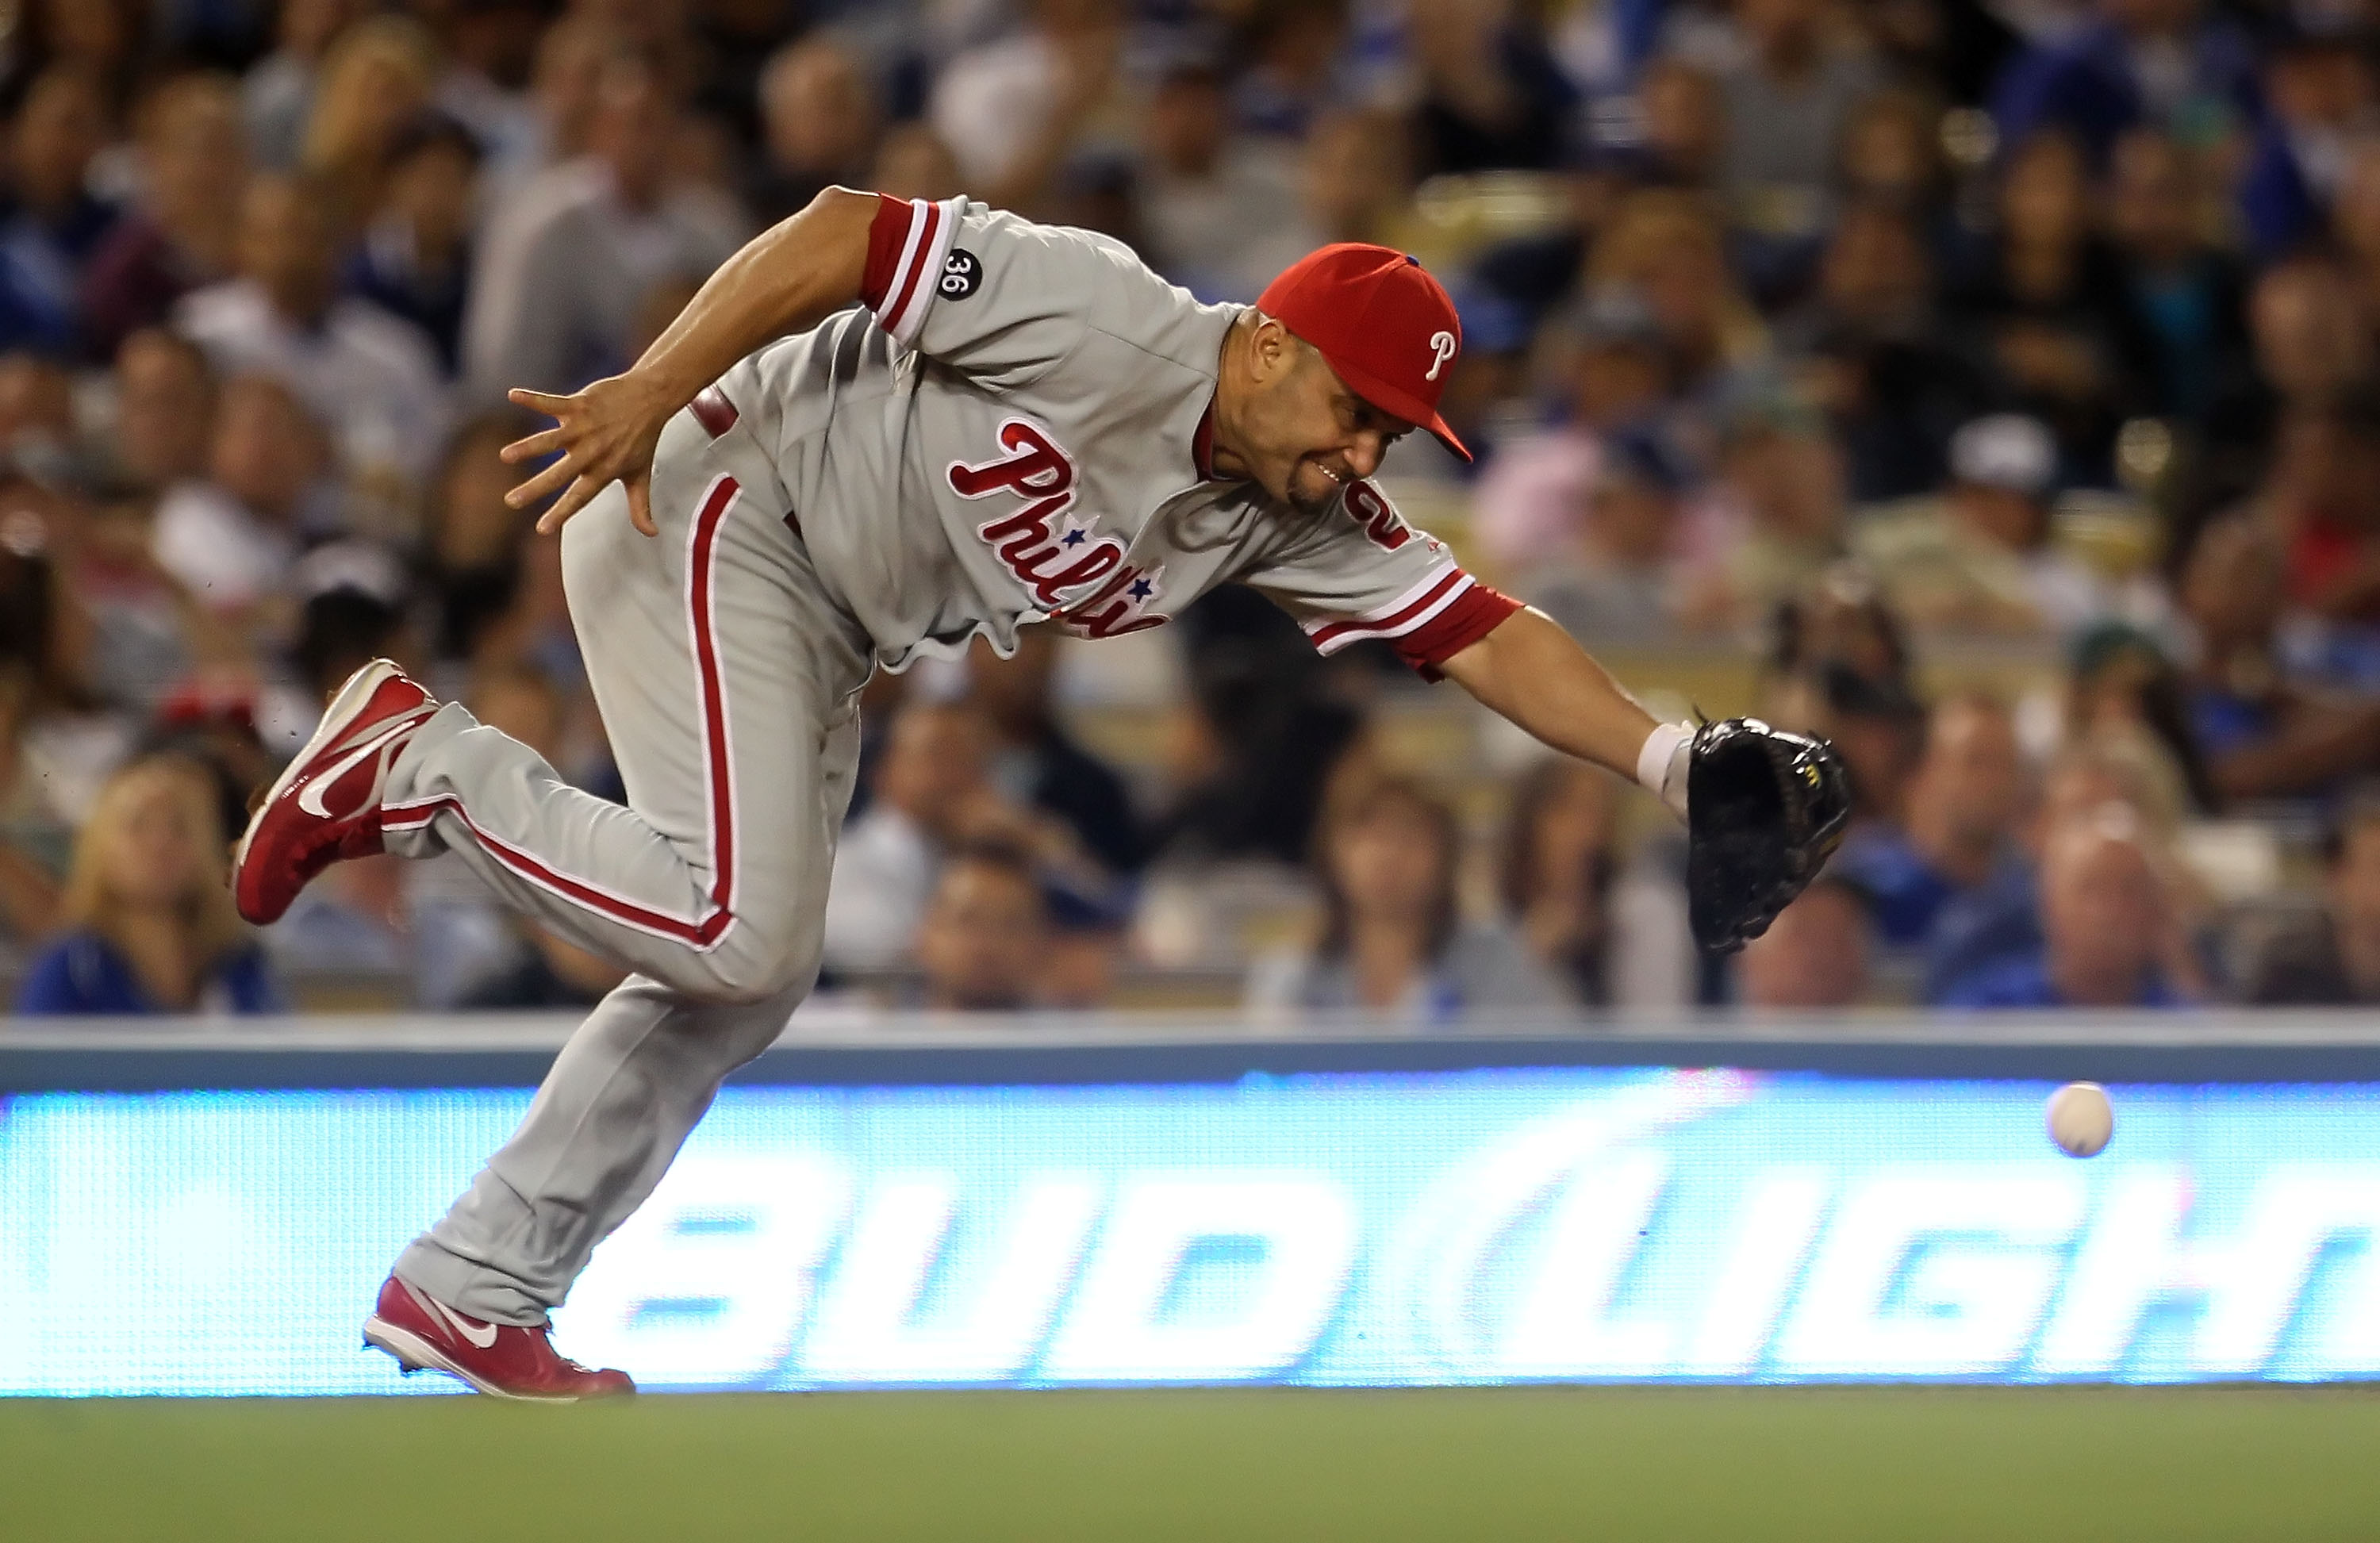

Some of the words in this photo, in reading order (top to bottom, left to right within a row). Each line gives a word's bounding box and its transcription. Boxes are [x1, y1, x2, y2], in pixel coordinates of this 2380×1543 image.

[941, 255, 972, 294] 36
[1426, 330, 1457, 381] P
[946, 416, 1173, 641] Philli
[554, 1147, 1357, 1374] BUD
